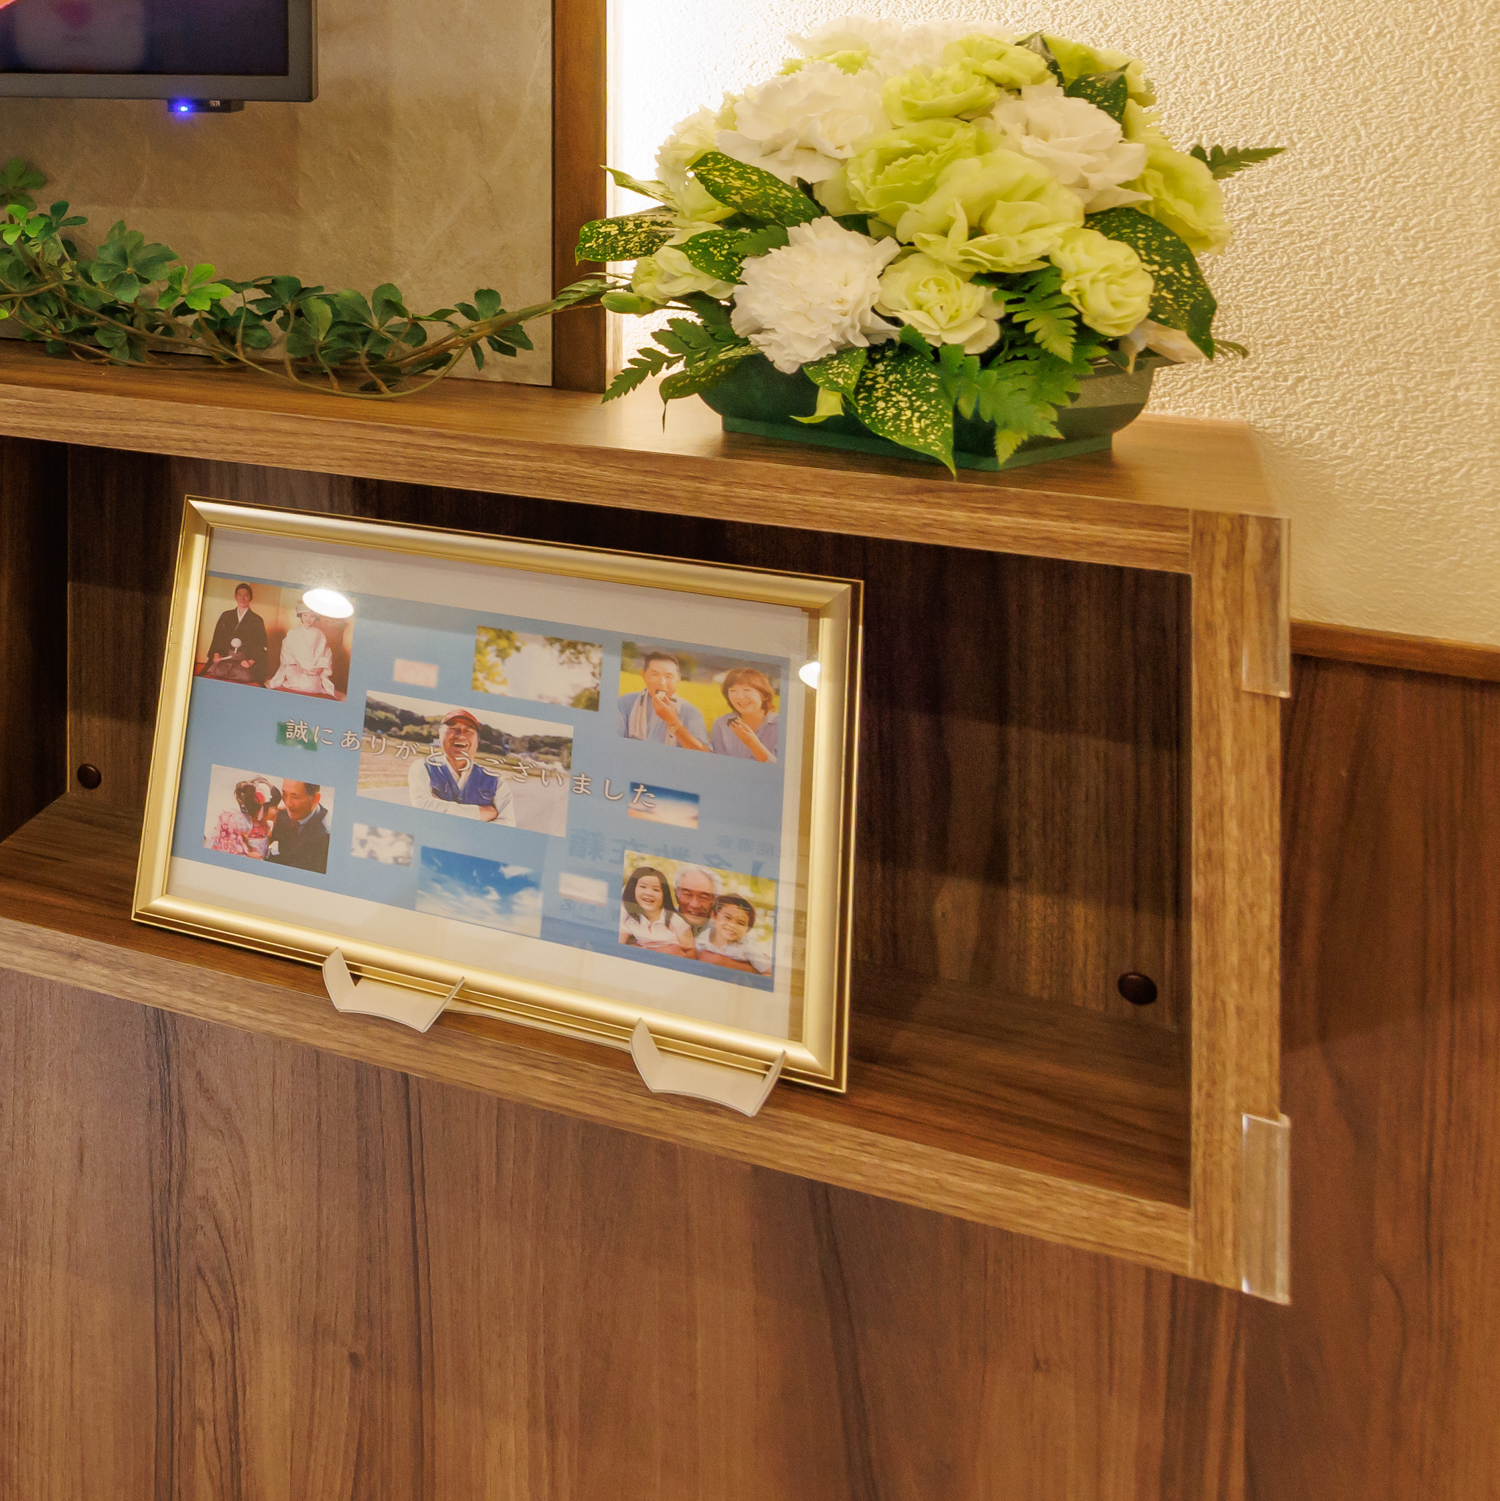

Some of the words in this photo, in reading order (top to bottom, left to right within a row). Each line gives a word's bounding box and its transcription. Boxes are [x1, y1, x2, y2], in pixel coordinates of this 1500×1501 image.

[285, 718, 657, 809] 誠にありがとうございました
